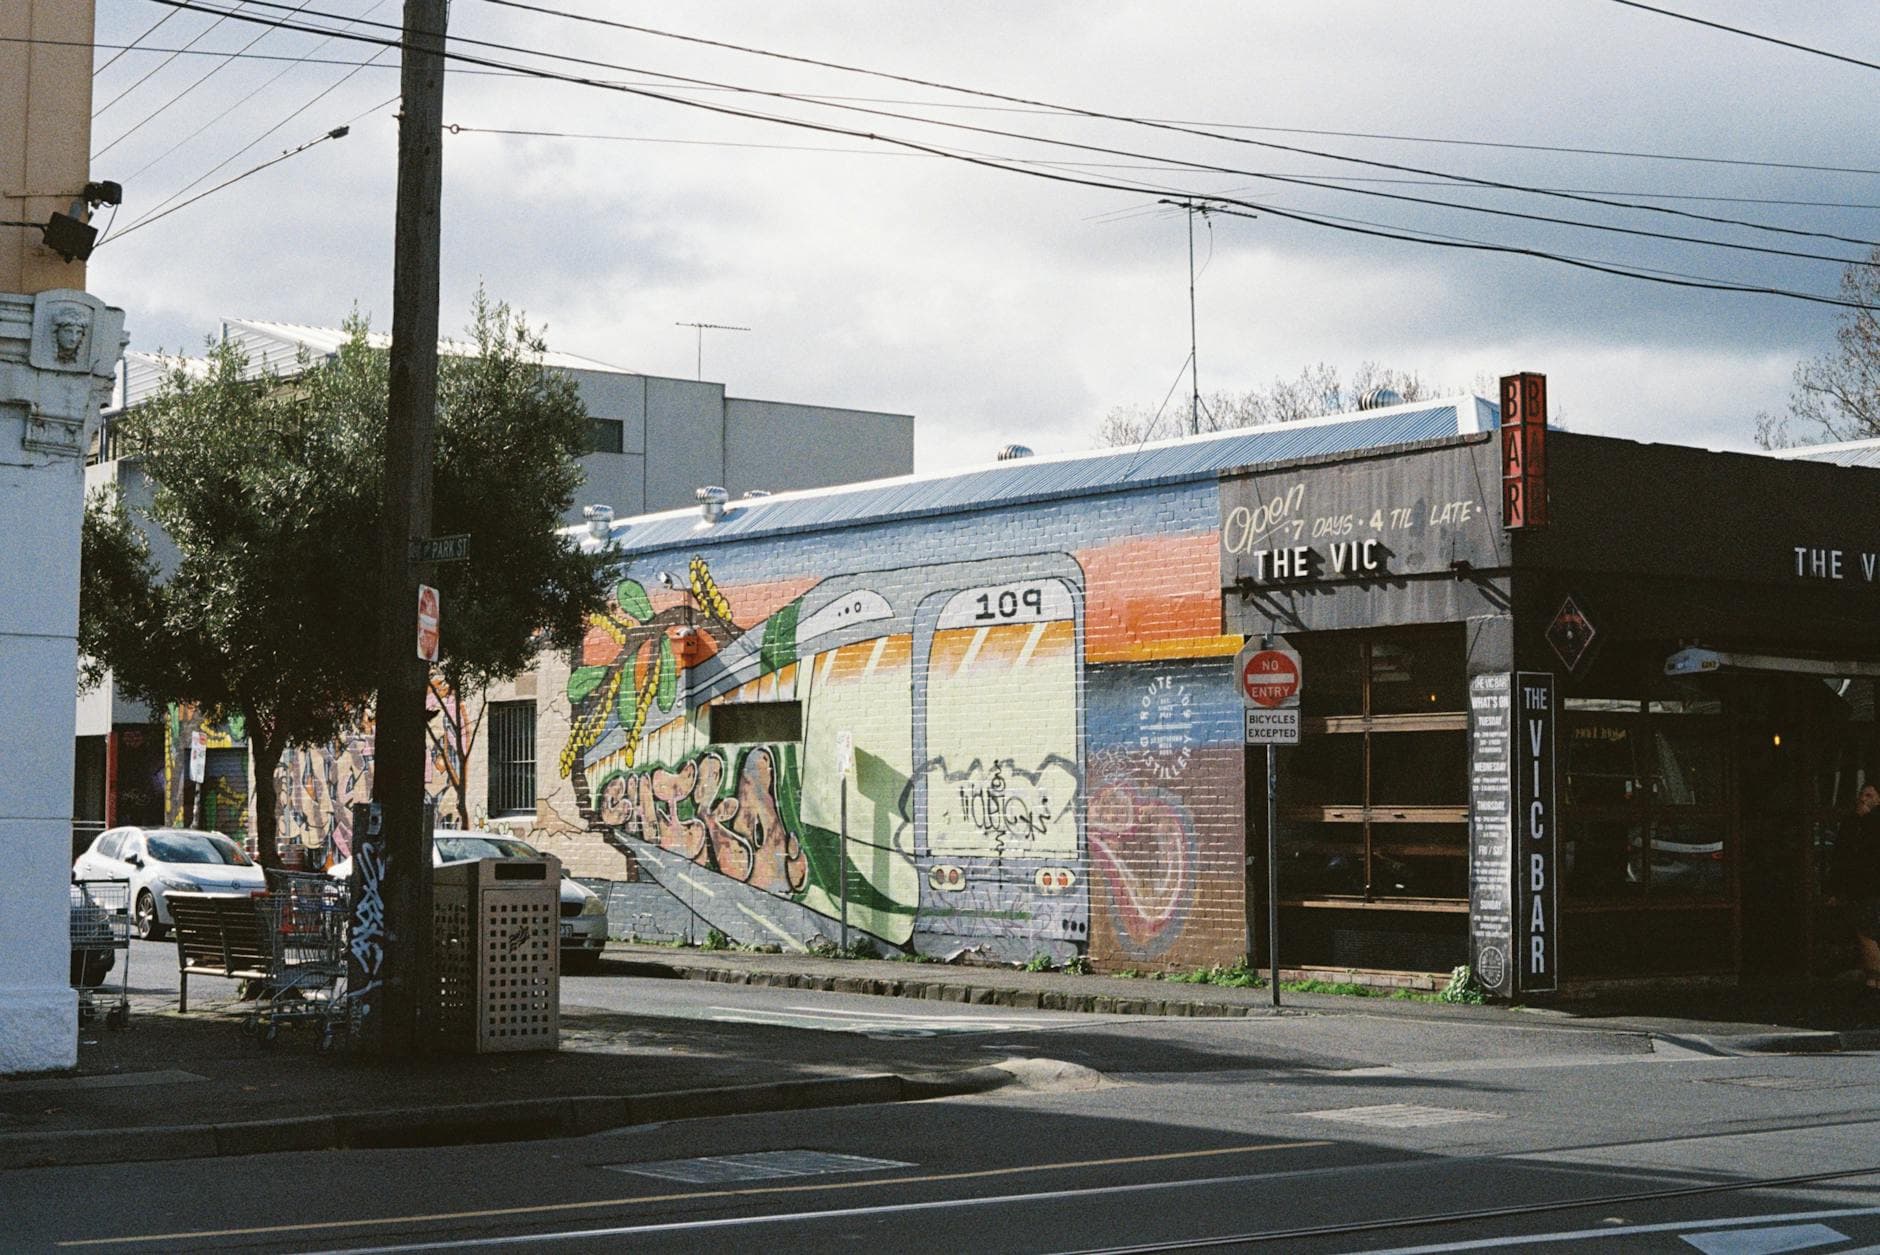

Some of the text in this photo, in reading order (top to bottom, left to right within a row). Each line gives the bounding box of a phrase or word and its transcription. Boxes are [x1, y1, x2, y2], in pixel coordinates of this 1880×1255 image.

[1504, 379, 1521, 524] BAR
[1223, 483, 1306, 555] Open
[1311, 513, 1354, 539] DAYS
[1369, 509, 1384, 532] 4
[1390, 507, 1414, 530] TIL
[1429, 500, 1473, 525] LATE
[432, 538, 455, 559] PARK
[456, 537, 468, 557] ST
[1253, 537, 1379, 581] THE VIC
[1794, 546, 1843, 580] THE
[974, 588, 1042, 621] 109
[1261, 659, 1279, 671] NO
[1140, 675, 1173, 721] ROUTE
[1251, 686, 1291, 699] ENTRY
[1471, 696, 1498, 709] WHAT'S
[1523, 687, 1548, 710] THE
[1249, 714, 1296, 724] BICYCLES
[1478, 715, 1503, 726] TUESDAY
[1248, 728, 1297, 738] EXCEPTED
[1140, 734, 1193, 779] DISTILLERY
[1474, 762, 1507, 772] WEDNESDAY
[1476, 800, 1506, 811] THURSDAY
[1529, 719, 1545, 974] VIC BAR
[1479, 900, 1502, 910] SUNDAY
